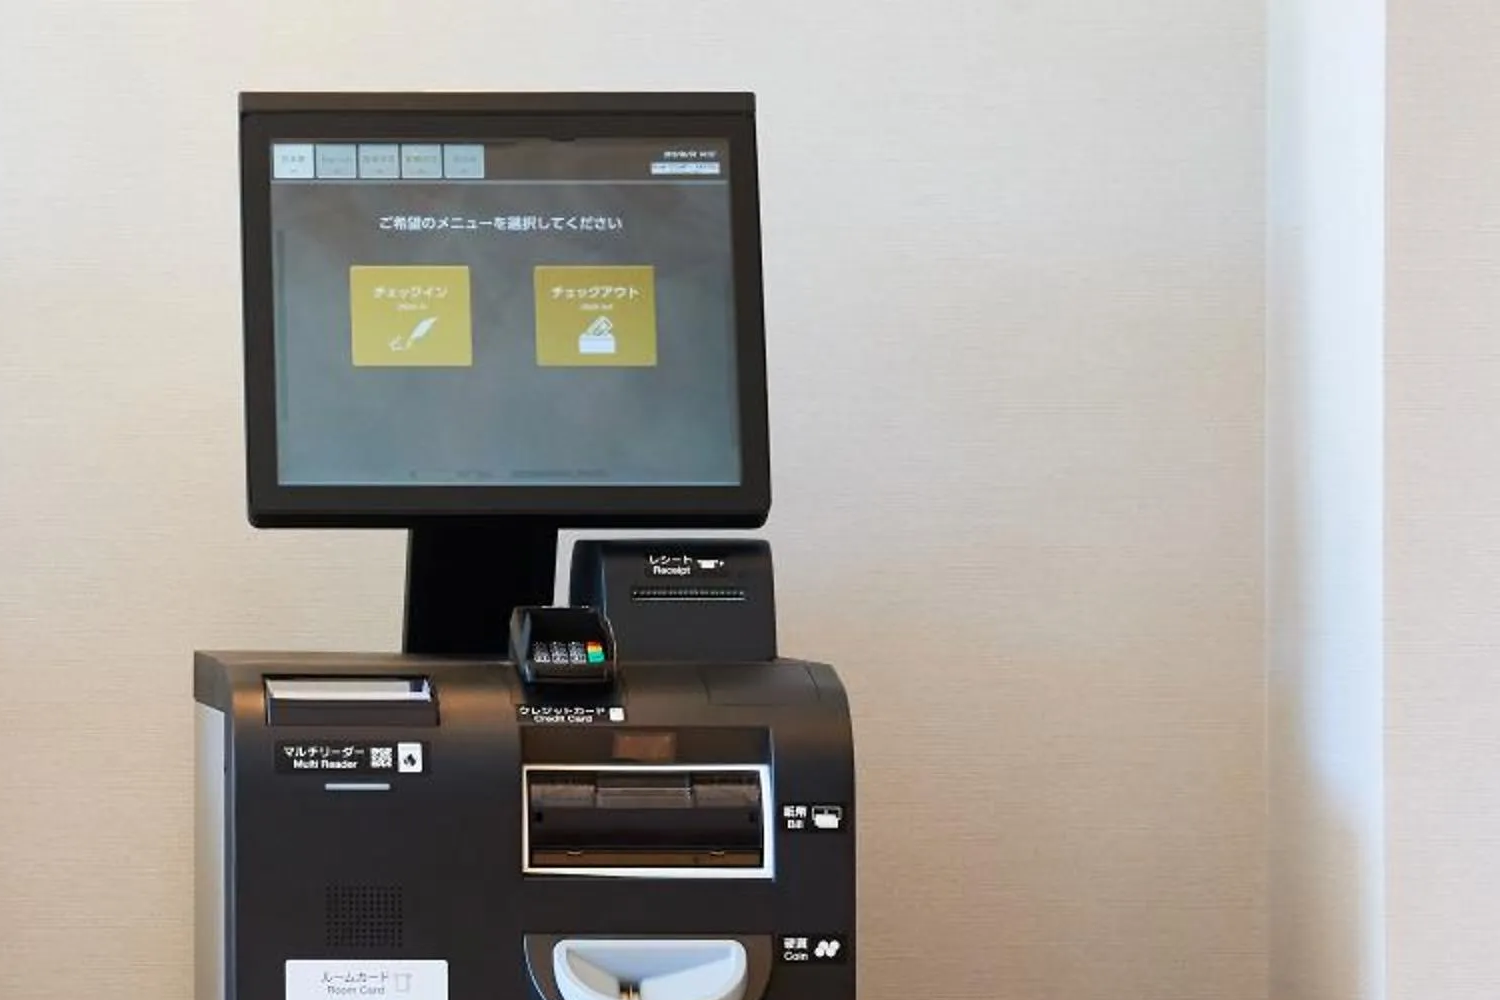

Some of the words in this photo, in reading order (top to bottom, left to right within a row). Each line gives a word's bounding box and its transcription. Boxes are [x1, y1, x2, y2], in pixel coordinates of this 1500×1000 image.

[379, 215, 623, 231] ご希望のメニューを選択してください
[551, 285, 640, 300] チェックアウト
[649, 555, 692, 565] レシート
[653, 565, 691, 576] Receipt
[567, 715, 593, 723] Card
[283, 746, 365, 758] マルチリーダー
[293, 759, 319, 769] Multi
[321, 759, 358, 769] Reader
[321, 971, 388, 983] ルームカード
[359, 985, 385, 995] Card
